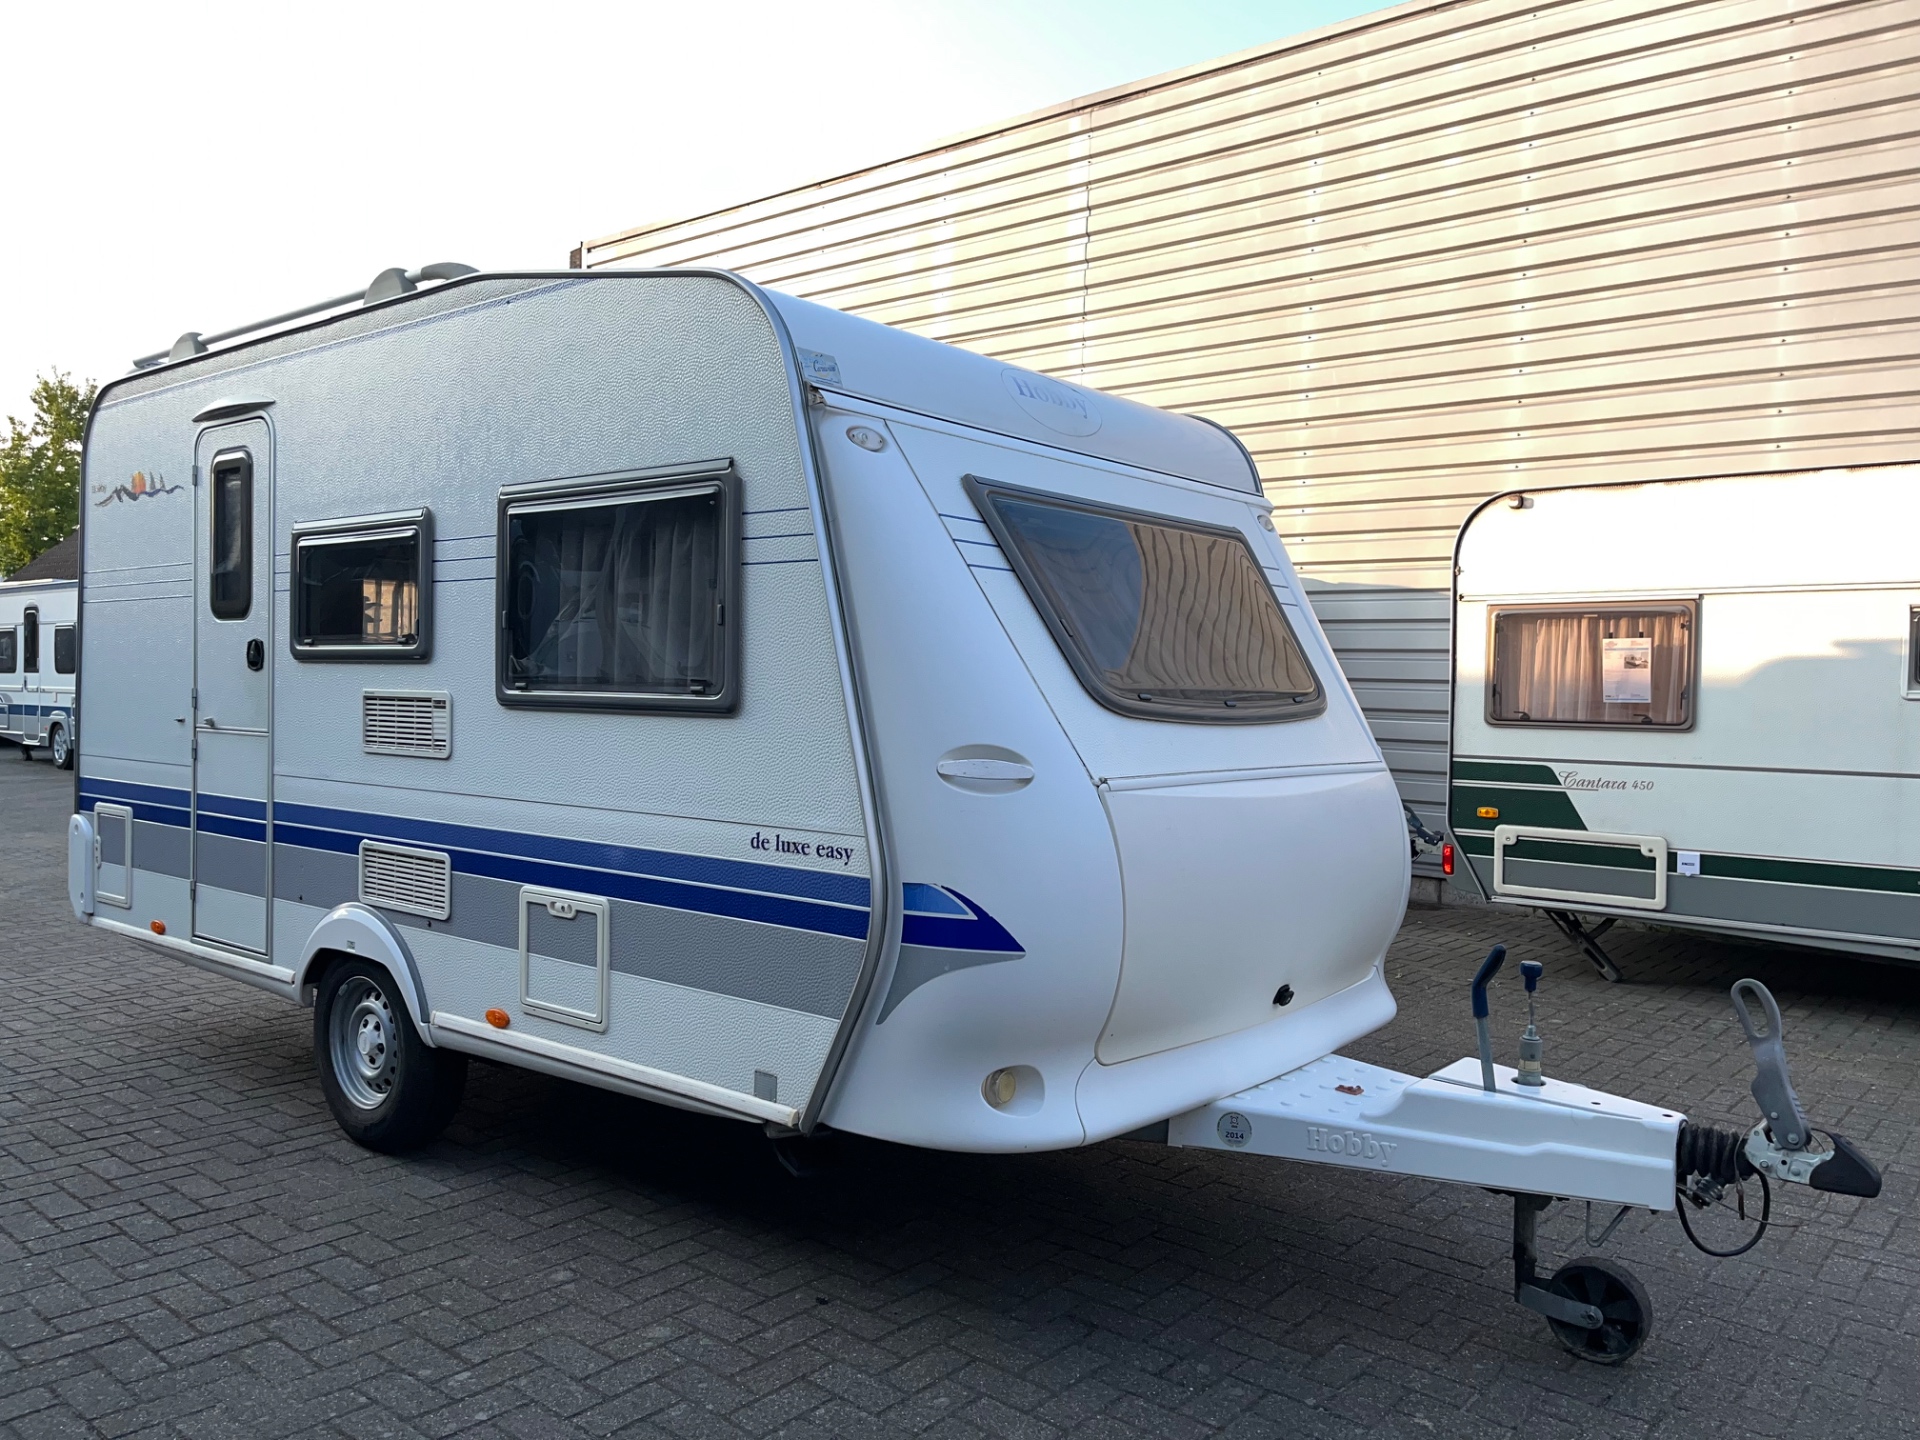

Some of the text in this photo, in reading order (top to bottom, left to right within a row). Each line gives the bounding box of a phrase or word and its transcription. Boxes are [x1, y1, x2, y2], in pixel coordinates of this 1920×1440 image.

[1011, 375, 1087, 419] Hobby
[1558, 771, 1654, 790] Cantara 450
[750, 832, 854, 866] de luxe easy
[1225, 1131, 1244, 1140] 2014
[1307, 1126, 1397, 1167] Hobby
